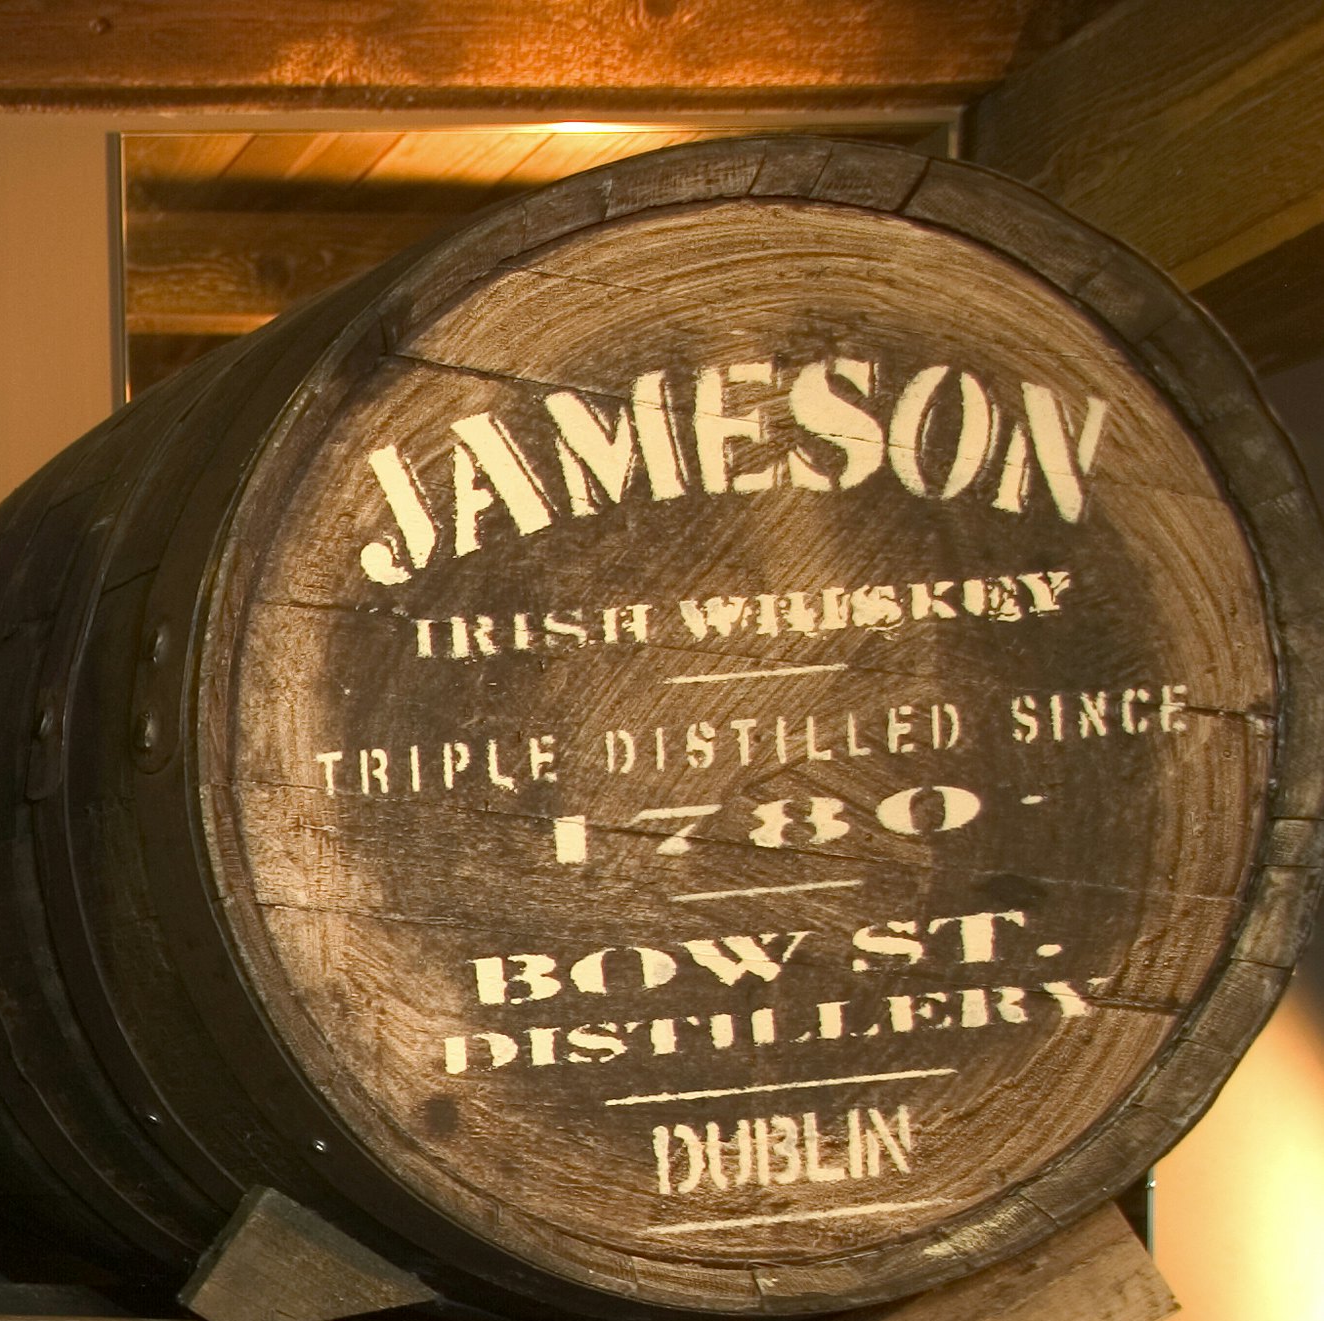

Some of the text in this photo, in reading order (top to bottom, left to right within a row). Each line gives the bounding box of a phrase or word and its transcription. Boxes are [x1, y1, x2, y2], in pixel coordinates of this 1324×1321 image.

[357, 358, 1108, 587] JAMESON
[414, 570, 1073, 661] IRISH WHISKEY
[315, 683, 1193, 798] TRIPLE DISTILLED SINCE
[466, 909, 1063, 1008] BOW ST.
[441, 975, 1116, 1076] DISTILLERY
[649, 1103, 913, 1196] DUBLIN
